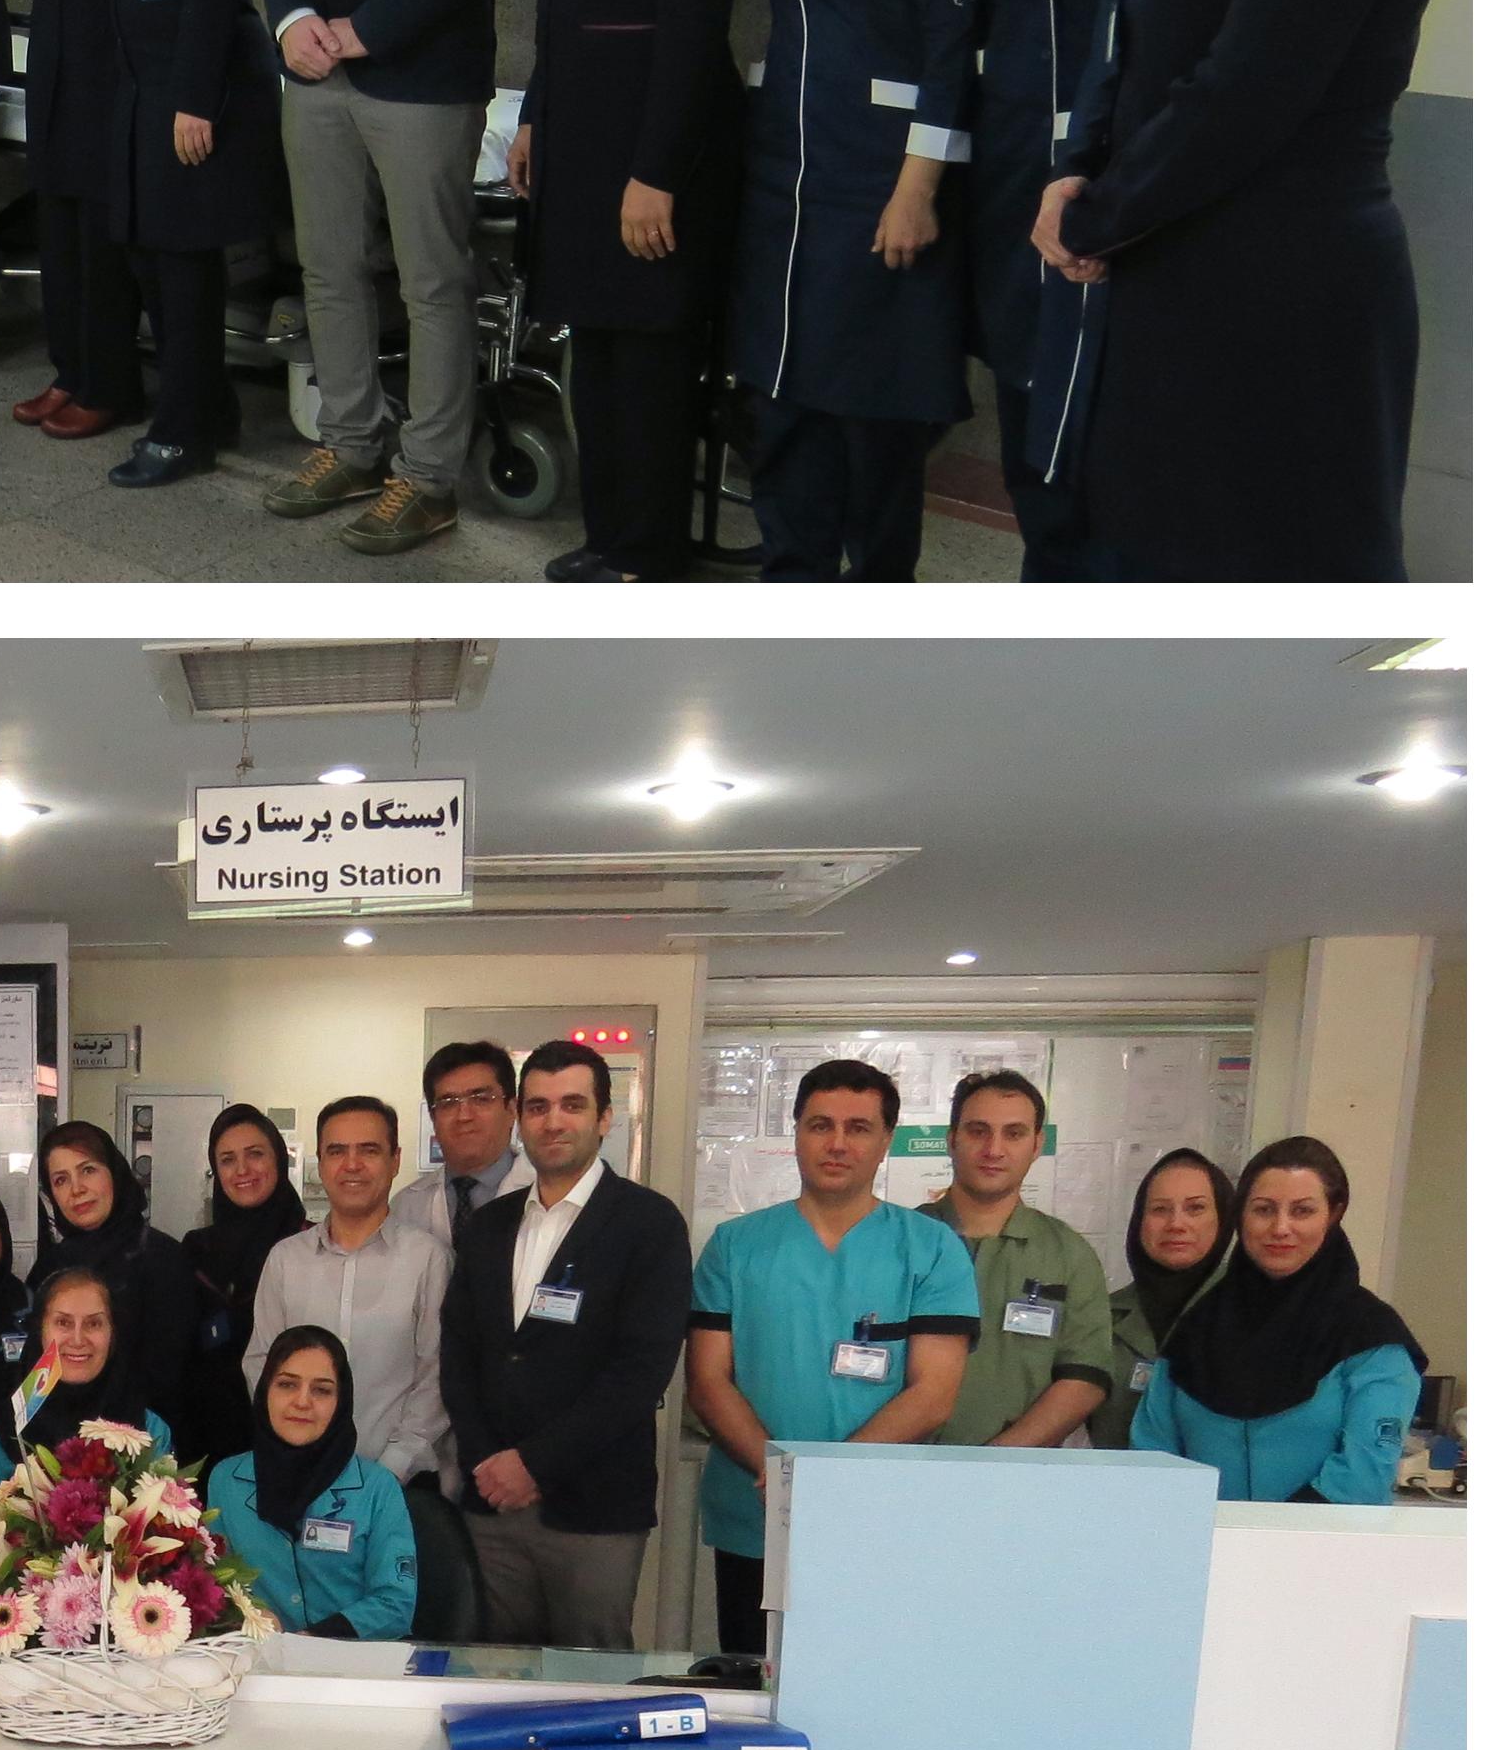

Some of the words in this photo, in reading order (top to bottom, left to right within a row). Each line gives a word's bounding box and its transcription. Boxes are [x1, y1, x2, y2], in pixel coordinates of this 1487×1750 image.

[202, 800, 332, 845] پرستاری
[341, 795, 459, 837] ایستگاه
[217, 866, 329, 893] Nursing
[339, 864, 442, 887] Station
